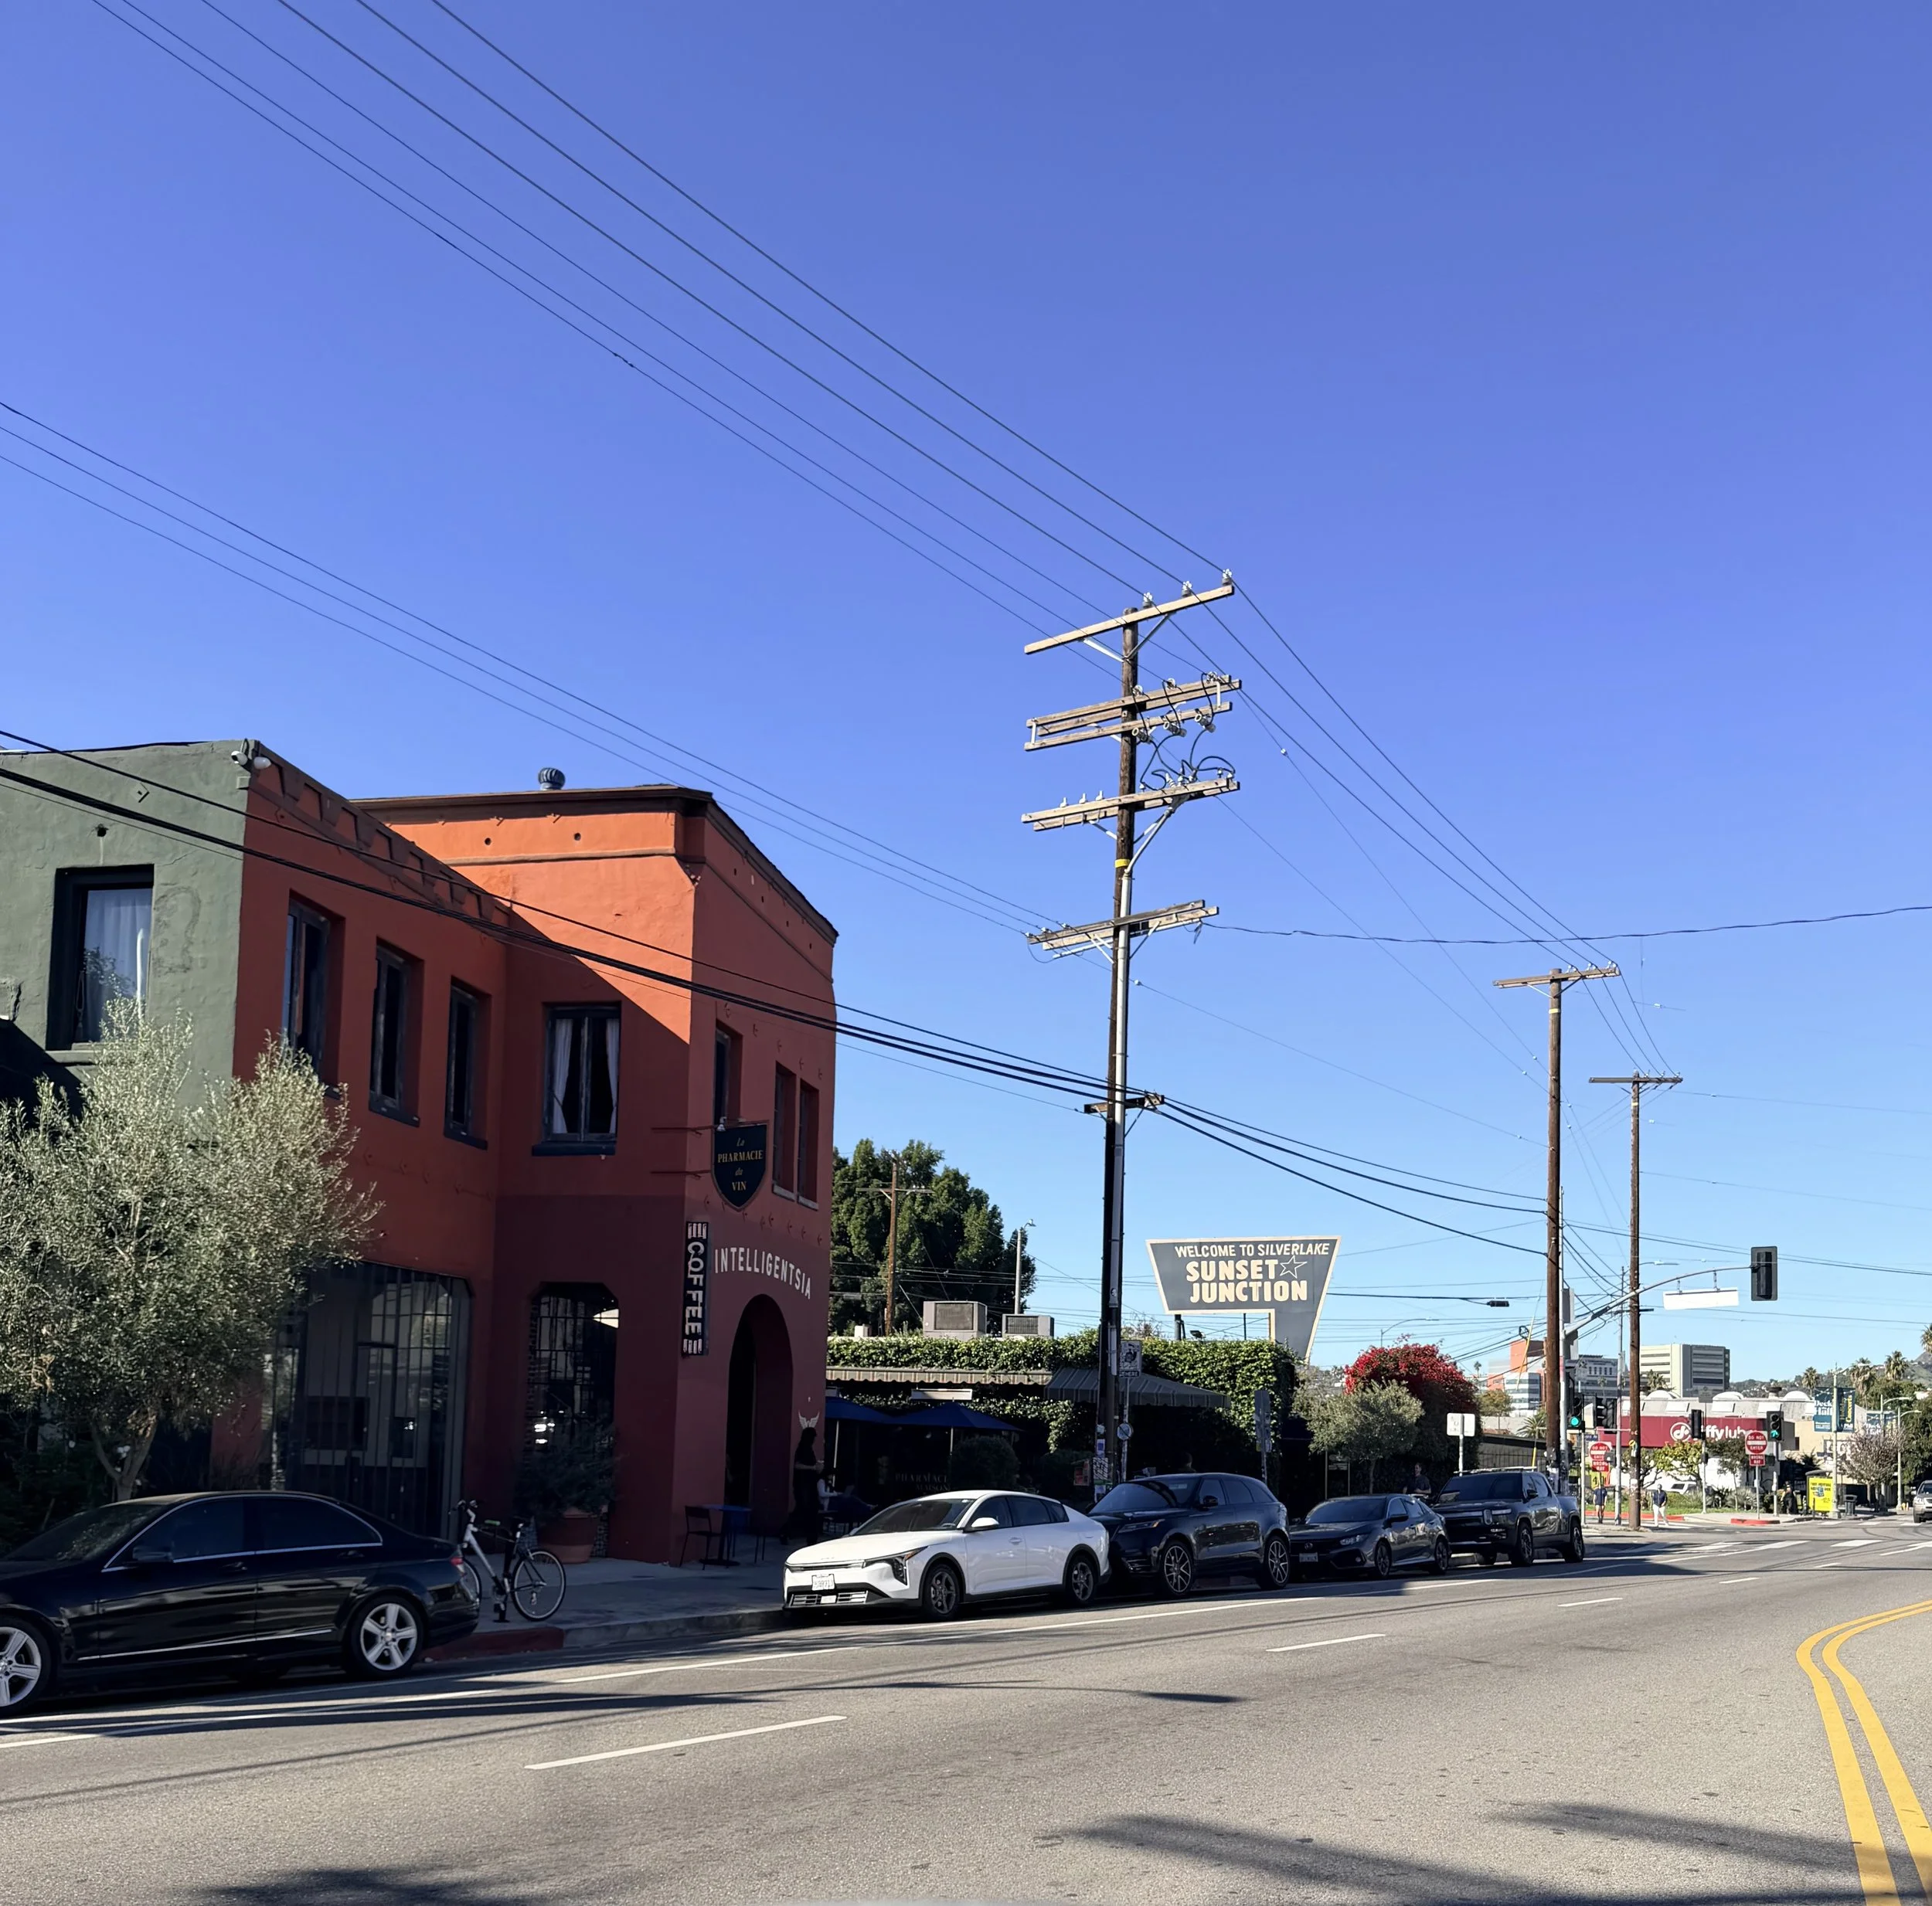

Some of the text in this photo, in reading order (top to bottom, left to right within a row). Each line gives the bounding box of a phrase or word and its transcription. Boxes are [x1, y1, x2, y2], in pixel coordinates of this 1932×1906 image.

[717, 1150, 764, 1163] PHARMACIE
[732, 1181, 747, 1191] VIN
[1175, 1242, 1330, 1258] WELCOME TO SILVERLAKE
[715, 1247, 811, 1300] INTELLIGENTSIA
[1185, 1259, 1278, 1283] SUNSET
[685, 1241, 705, 1336] COFFEE
[1189, 1280, 1308, 1303] JUNCTION
[1726, 1425, 1753, 1439] lub
